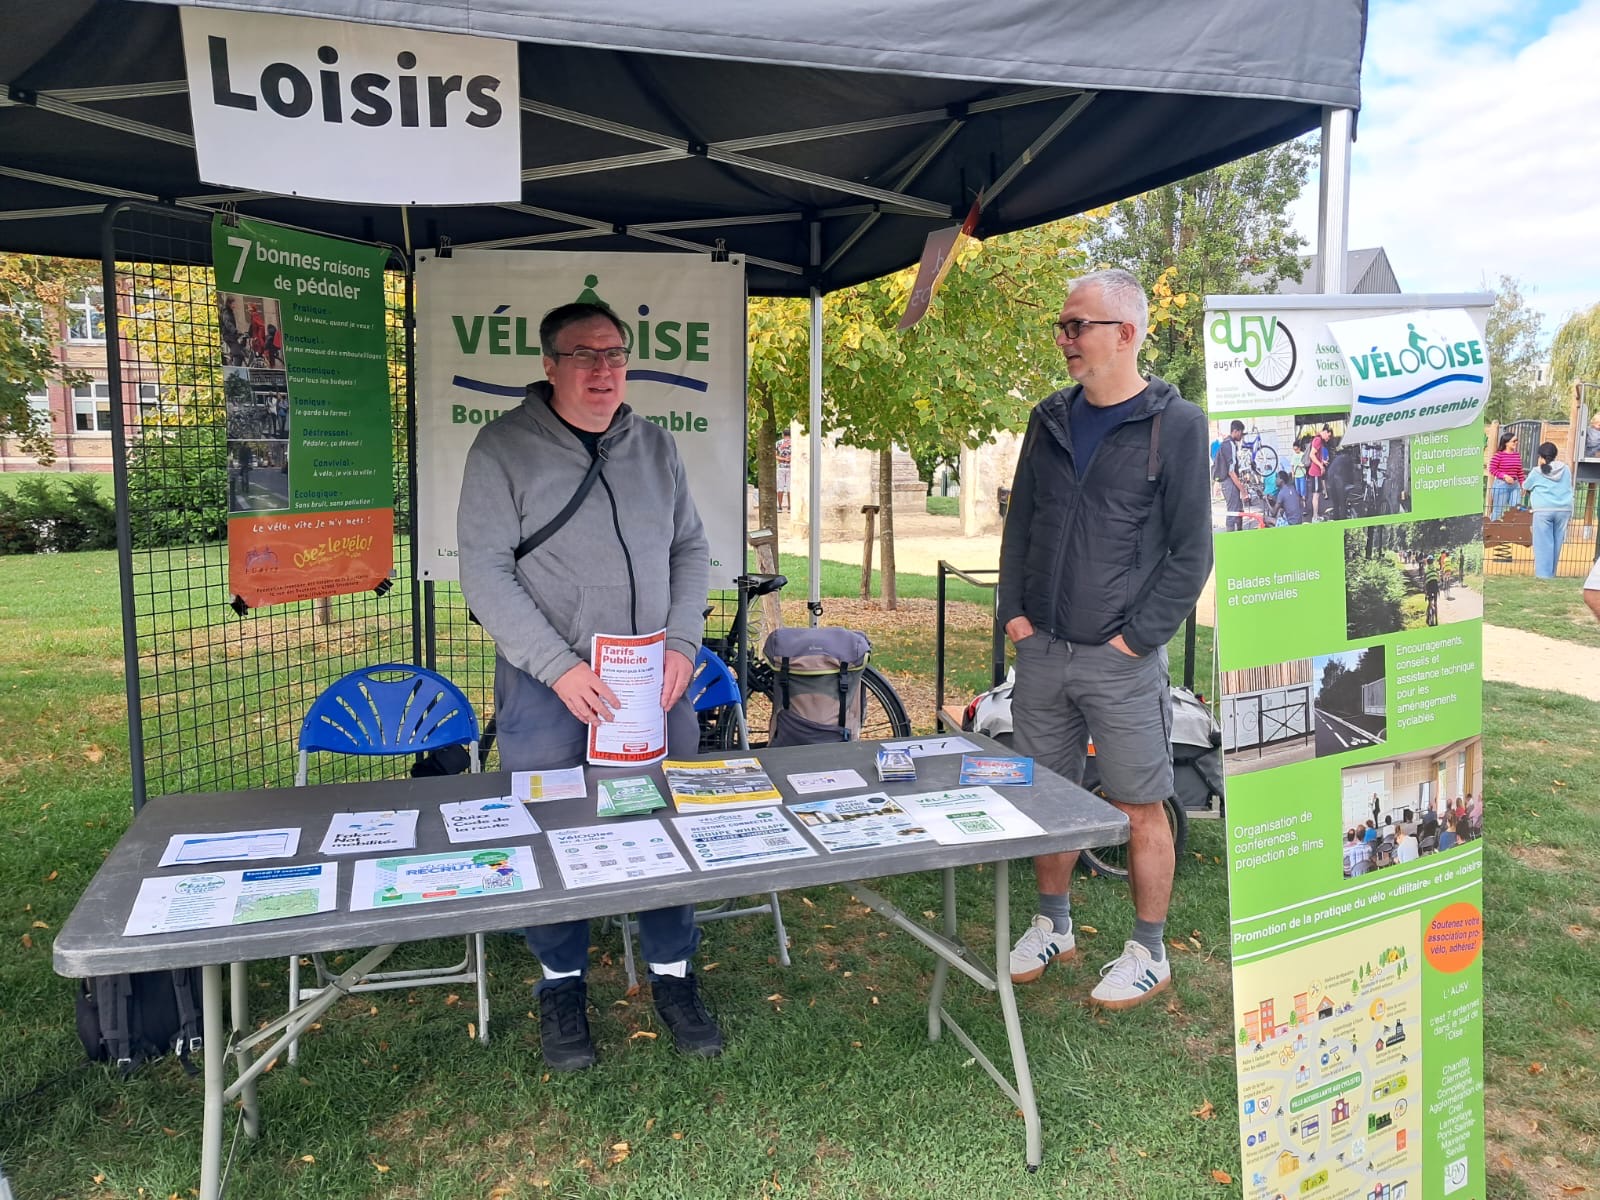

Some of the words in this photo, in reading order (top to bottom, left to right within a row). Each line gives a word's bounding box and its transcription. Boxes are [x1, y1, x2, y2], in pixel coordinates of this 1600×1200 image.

[208, 35, 502, 128] Loisirs
[228, 236, 252, 283] 7
[256, 241, 320, 271] bonnes
[324, 260, 370, 278] raisons
[274, 274, 291, 290] de
[297, 277, 360, 300] pédaler
[330, 320, 348, 328] quand
[1214, 358, 1242, 371] au5v.fr
[1316, 359, 1339, 370] Voies
[330, 378, 352, 386] budgets
[1317, 376, 1327, 387] de
[1352, 408, 1416, 427] Bougeons
[1419, 397, 1479, 418] ensemble
[1414, 434, 1448, 445] Ateliers
[1414, 446, 1481, 460] d'autoréparation
[1415, 464, 1434, 474] vélo
[1436, 463, 1445, 473] et
[1415, 474, 1479, 490] d'apprentissage
[295, 501, 309, 509] Sans
[345, 498, 370, 506] pollution
[253, 524, 263, 533] Le
[268, 522, 291, 531] vélo,
[294, 521, 312, 529] vite
[329, 518, 341, 526] m'y
[346, 518, 363, 526] mets
[294, 544, 326, 569] Osez
[328, 537, 341, 553] le
[342, 534, 373, 552] vélo!
[1228, 577, 1271, 591] Balades
[1274, 568, 1320, 585] familiales
[1228, 594, 1239, 607] et
[1242, 586, 1298, 604] conviviales
[604, 646, 634, 655] Tarifs
[603, 655, 648, 664] Publicité
[1396, 656, 1430, 670] conseils
[1432, 654, 1439, 663] et
[1397, 670, 1440, 685] assistance
[1441, 662, 1475, 676] technique
[1397, 688, 1415, 700] pour
[1418, 685, 1430, 695] les
[1397, 694, 1457, 714] aménagements
[1397, 713, 1435, 729] cyclables
[691, 830, 730, 839] GROUPE
[735, 823, 784, 834] WHATSAPP
[1234, 816, 1298, 838] Organisation
[1301, 811, 1313, 823] de
[1235, 831, 1298, 854] conférences,
[1236, 850, 1284, 872] projection
[1288, 844, 1300, 856] de
[1302, 839, 1324, 852] films
[406, 863, 485, 875] RECRUTE
[1234, 923, 1287, 944] Promotion
[1289, 918, 1301, 929] de
[1304, 914, 1312, 925] la
[1314, 903, 1352, 924] pratique
[1354, 898, 1366, 909] du
[1368, 891, 1386, 903] vélo
[1389, 880, 1431, 896] «utilitaire»
[1434, 874, 1443, 884] et
[1444, 871, 1454, 880] de
[1431, 920, 1463, 930] Soutenez
[1464, 916, 1480, 925] votre
[1428, 931, 1466, 942] association
[1468, 930, 1480, 940] pro-
[1430, 946, 1448, 955] vélo,
[1430, 1012, 1445, 1026] c'est
[1447, 1010, 1451, 1020] 7
[1452, 998, 1480, 1018] antennes
[1434, 1023, 1450, 1036] dans
[1452, 1020, 1458, 1028] le
[1460, 1016, 1470, 1025] sud
[1471, 1010, 1479, 1020] de
[1446, 1029, 1463, 1041] l'Oise
[1443, 1056, 1470, 1075] Chantilly
[1442, 1067, 1471, 1086] Clermont
[1437, 1077, 1473, 1099] Compiègne
[1261, 1100, 1269, 1109] 30
[1291, 1099, 1303, 1108] VILLE
[1304, 1088, 1332, 1105] ACCUEILLANTE
[1429, 1087, 1475, 1114] Agglomération
[1448, 1101, 1464, 1115] Creil
[1440, 1109, 1472, 1130] Lamorlaye
[1441, 1131, 1470, 1150] Maxence
[1446, 1143, 1466, 1158] Senlis
